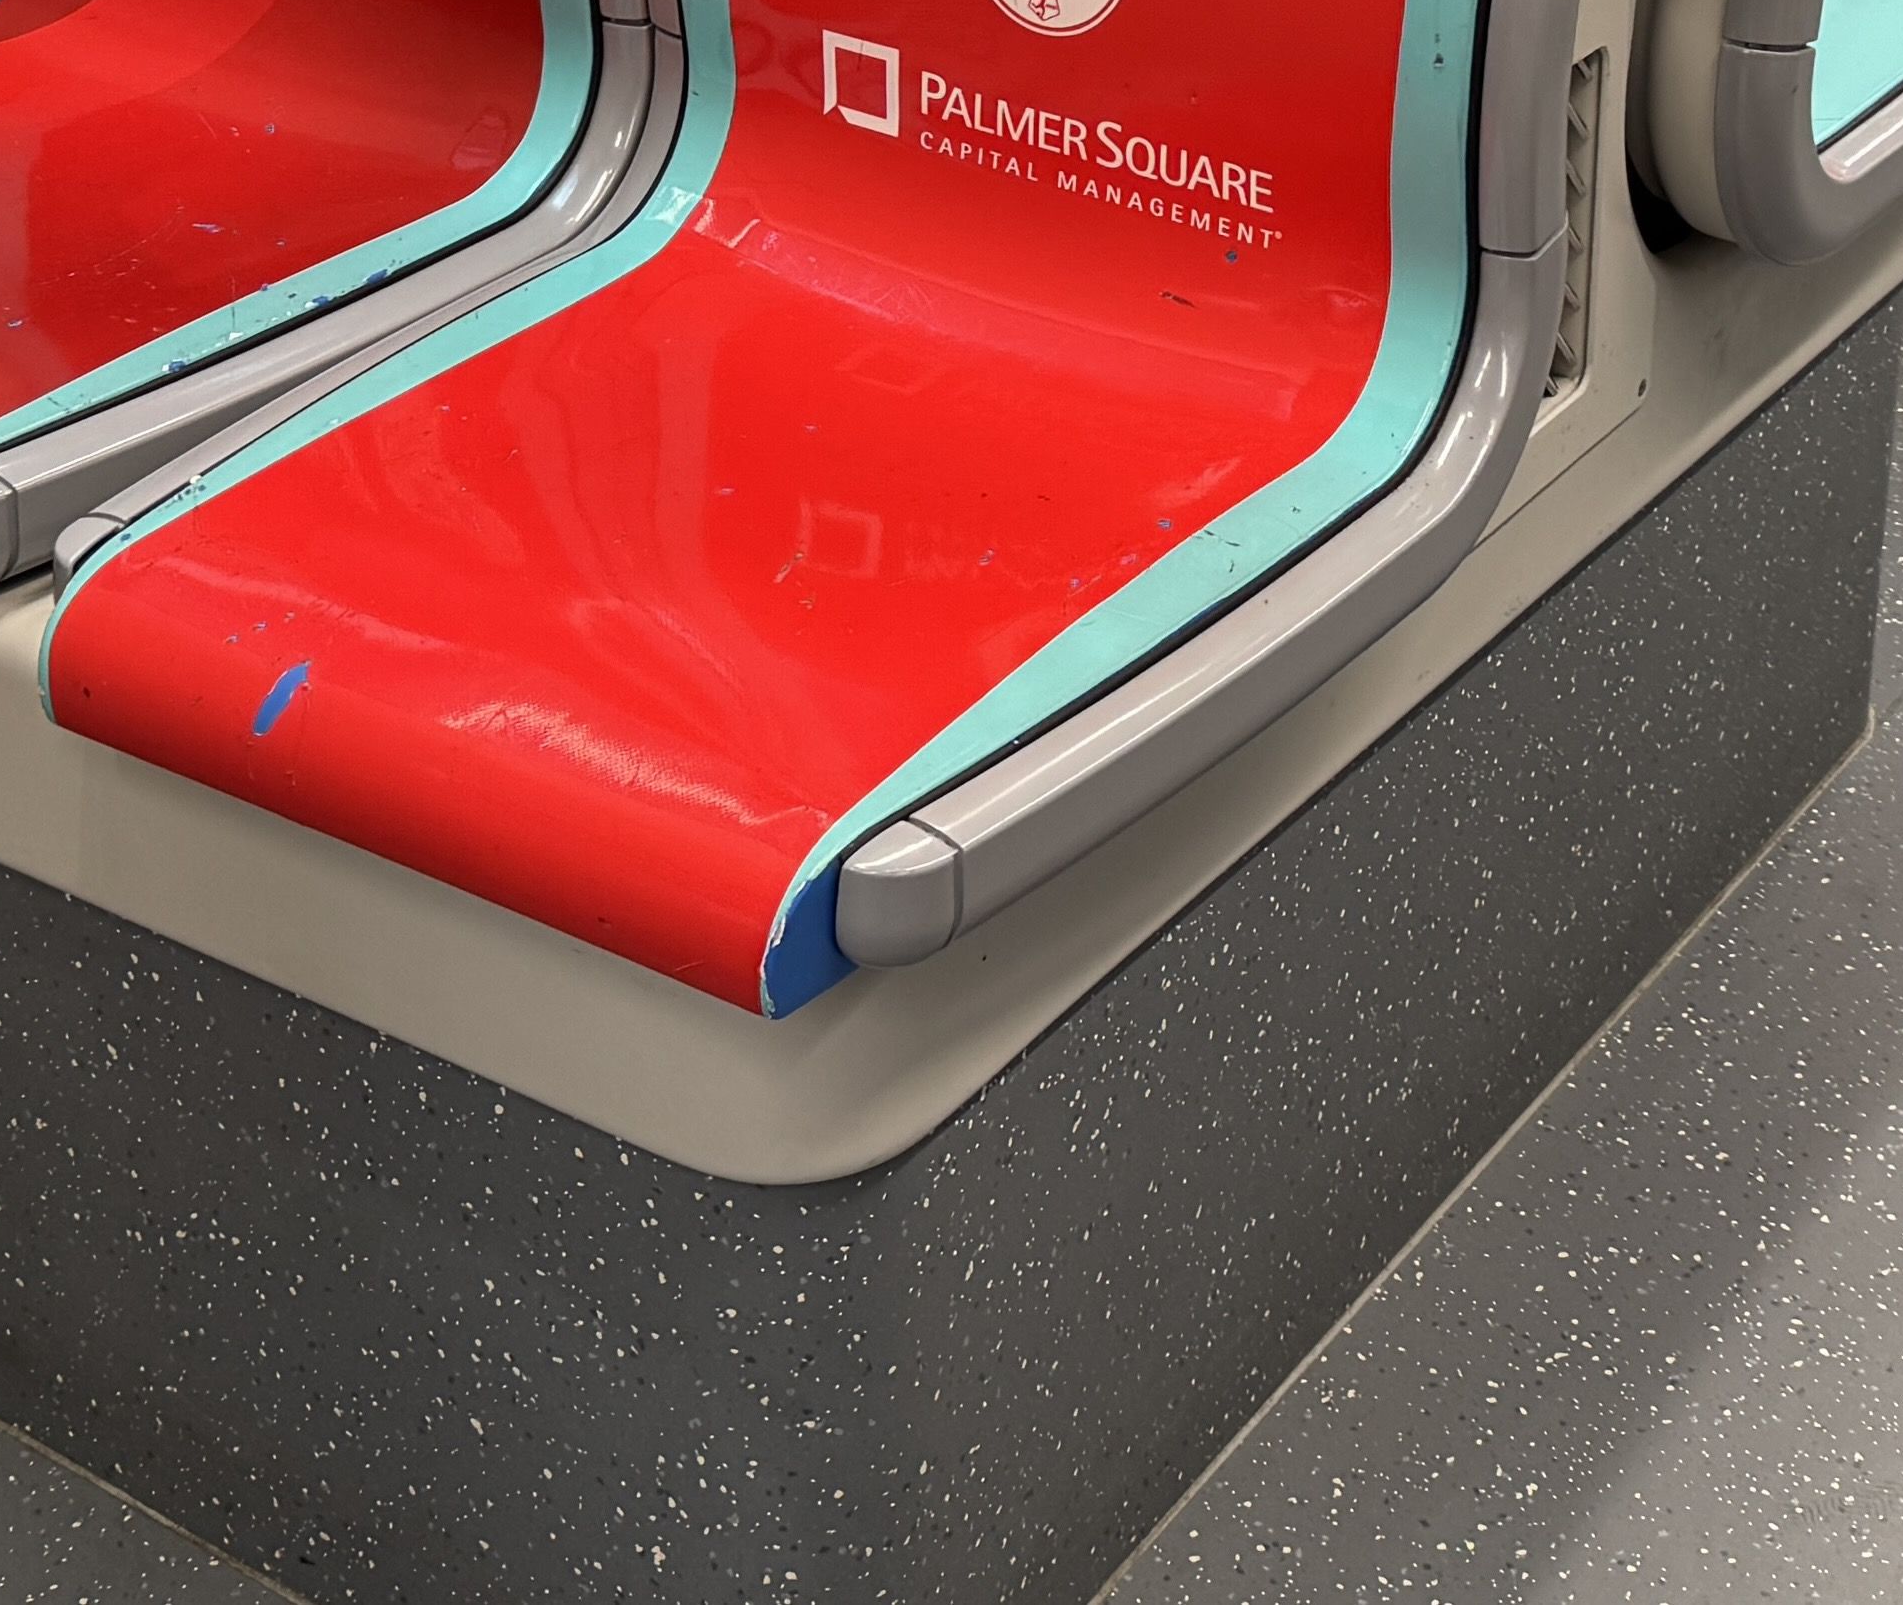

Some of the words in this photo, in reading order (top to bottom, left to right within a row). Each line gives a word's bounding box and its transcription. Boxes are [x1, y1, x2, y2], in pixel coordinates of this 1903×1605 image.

[920, 70, 1087, 160] PALMER
[1095, 120, 1274, 214] SQUARE
[920, 131, 1039, 182] CAPITAL
[1056, 170, 1278, 250] MANAGEMENT
